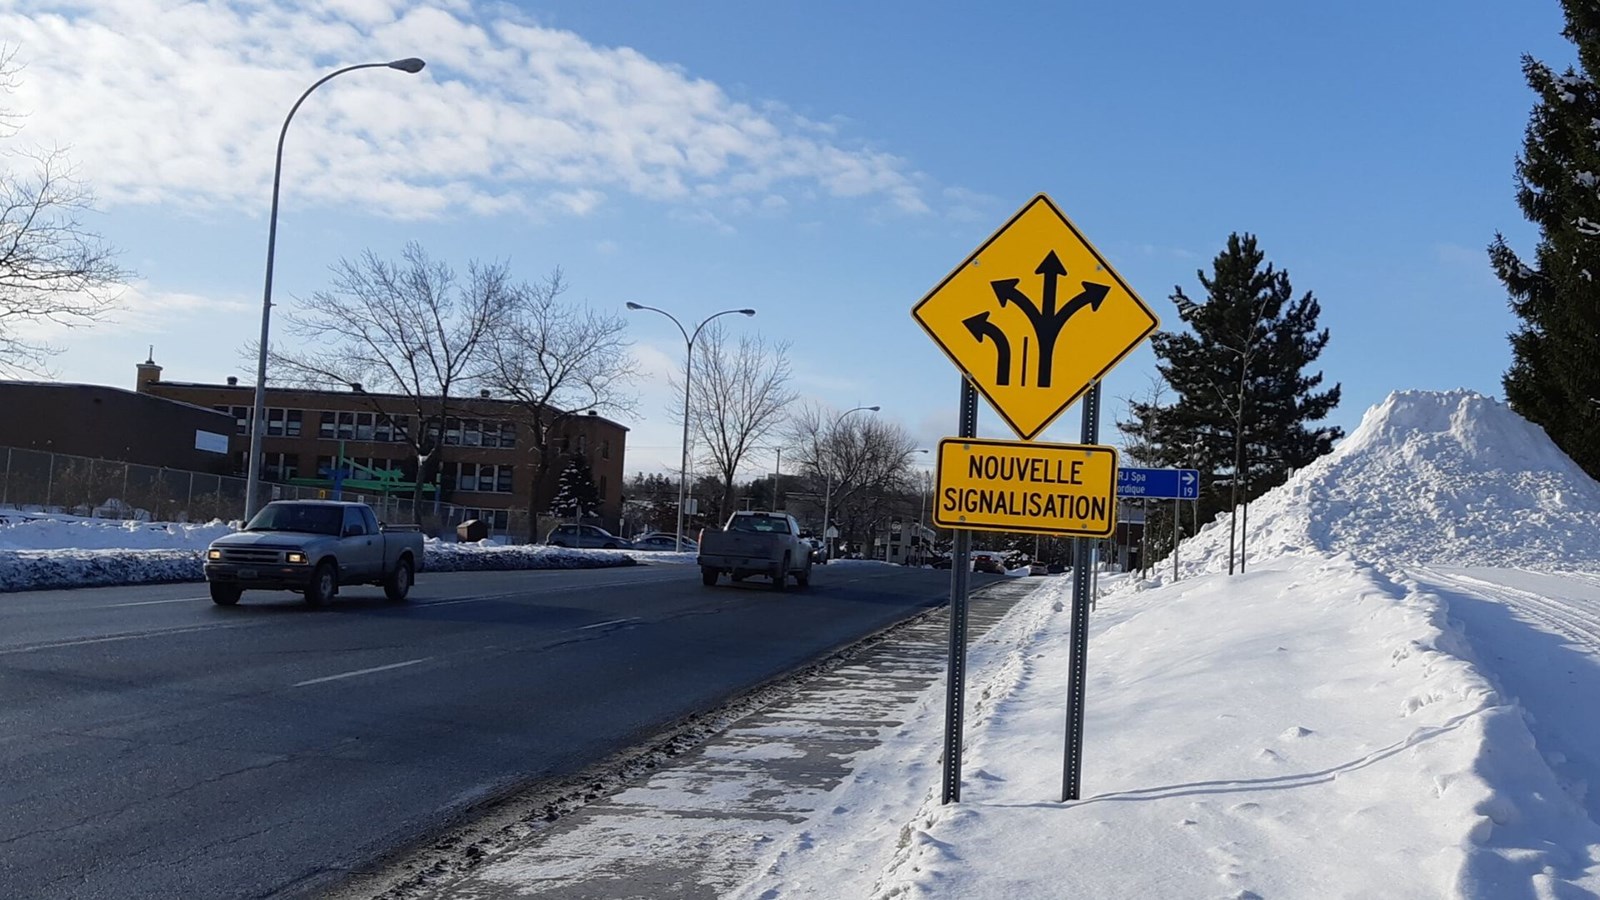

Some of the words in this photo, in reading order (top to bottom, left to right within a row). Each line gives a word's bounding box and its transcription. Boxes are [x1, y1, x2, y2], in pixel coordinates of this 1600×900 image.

[969, 455, 1083, 485] NOUVELLE
[1118, 471, 1129, 481] RJ
[1131, 472, 1146, 483] Spa
[1117, 484, 1145, 495] ordique
[1183, 487, 1193, 496] 19
[943, 488, 1106, 521] SIGNALISATION
